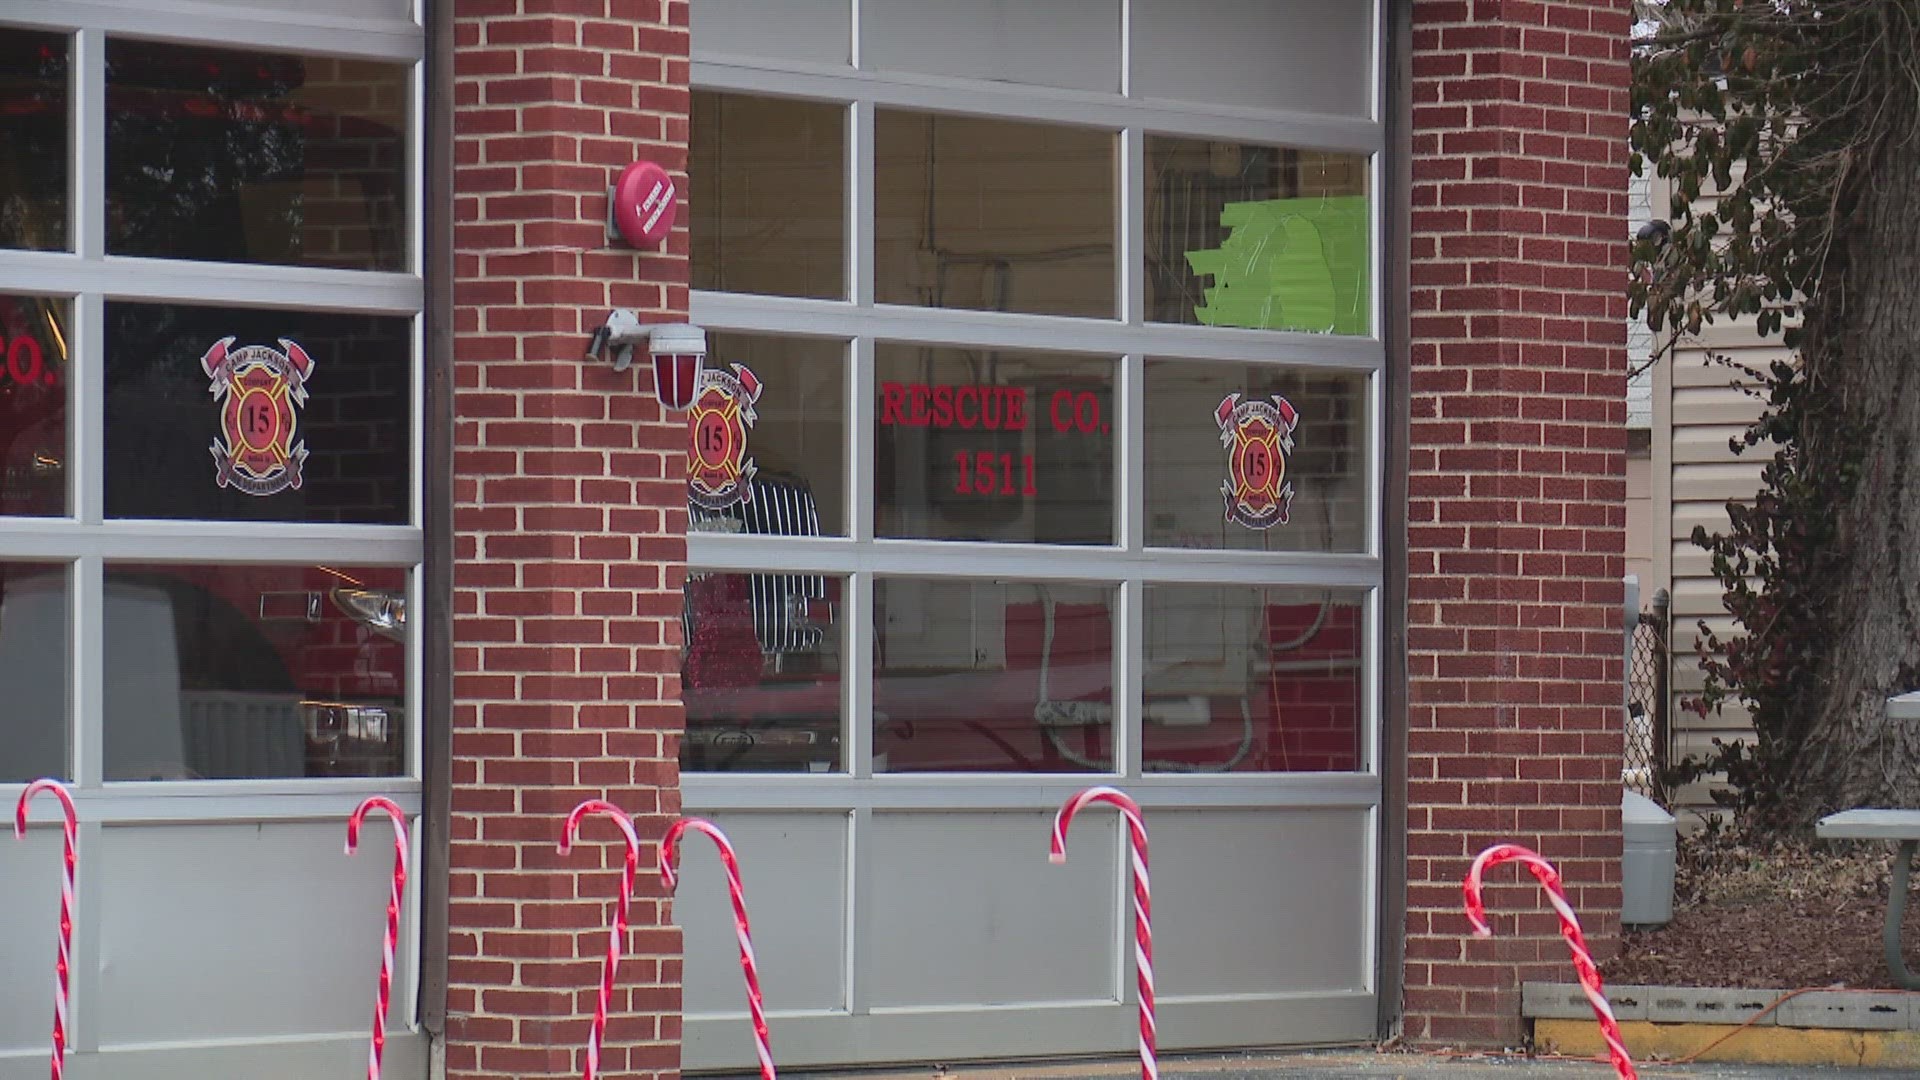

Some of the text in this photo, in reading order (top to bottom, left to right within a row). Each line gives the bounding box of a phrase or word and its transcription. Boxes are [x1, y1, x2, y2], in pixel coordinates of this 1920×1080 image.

[0, 335, 57, 385] O.
[226, 349, 290, 375] CAMP JACKSON
[708, 373, 741, 397] JACKSON
[248, 406, 269, 432] 15
[880, 381, 1110, 437] RESCUE CO.
[1233, 404, 1280, 426] CAMP JACKSON
[704, 426, 723, 451] 15
[955, 449, 1037, 496] 1511
[1249, 452, 1265, 476] 15
